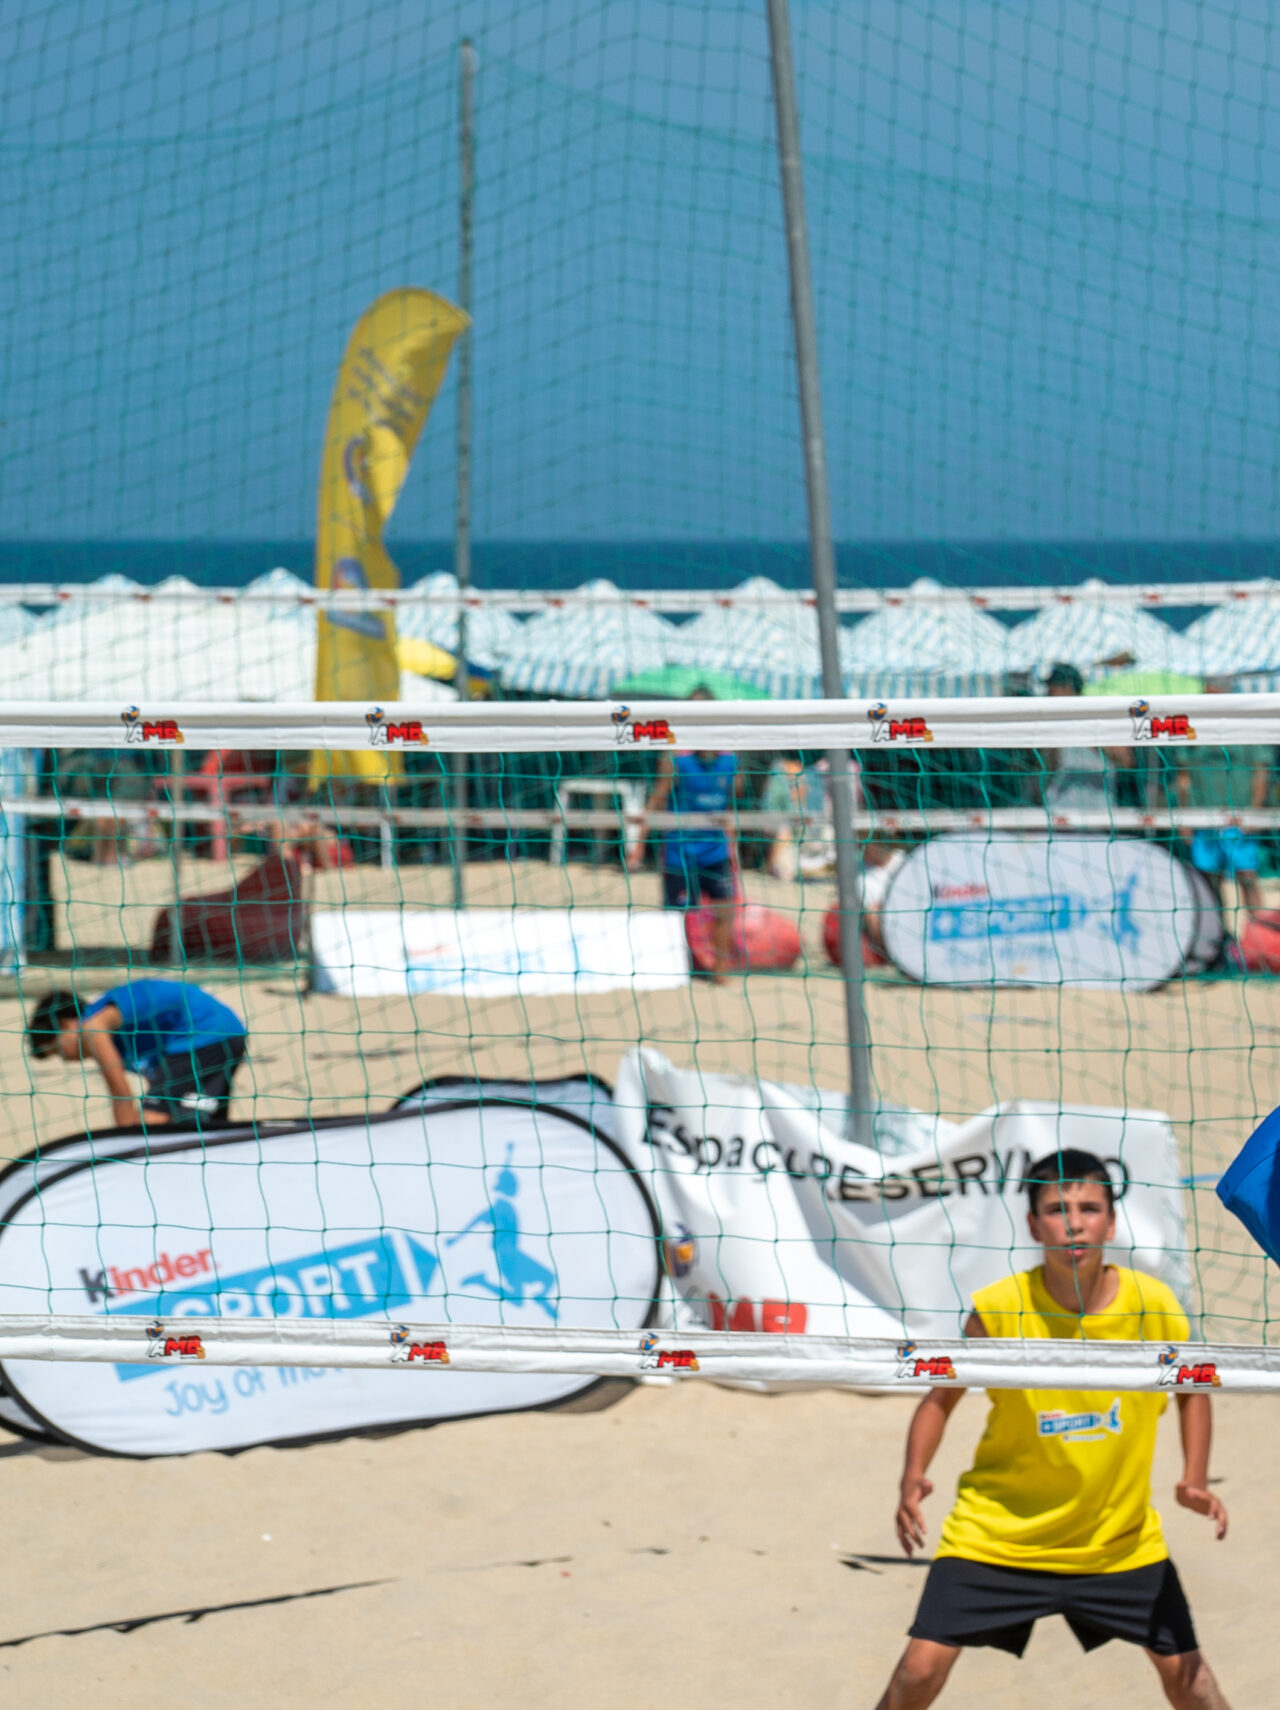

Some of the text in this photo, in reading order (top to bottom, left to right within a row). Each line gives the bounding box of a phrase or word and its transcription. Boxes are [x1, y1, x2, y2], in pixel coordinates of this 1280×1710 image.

[811, 1149, 1128, 1201] RESERV
[80, 1248, 213, 1304] Kinder
[164, 1380, 230, 1416] Joy
